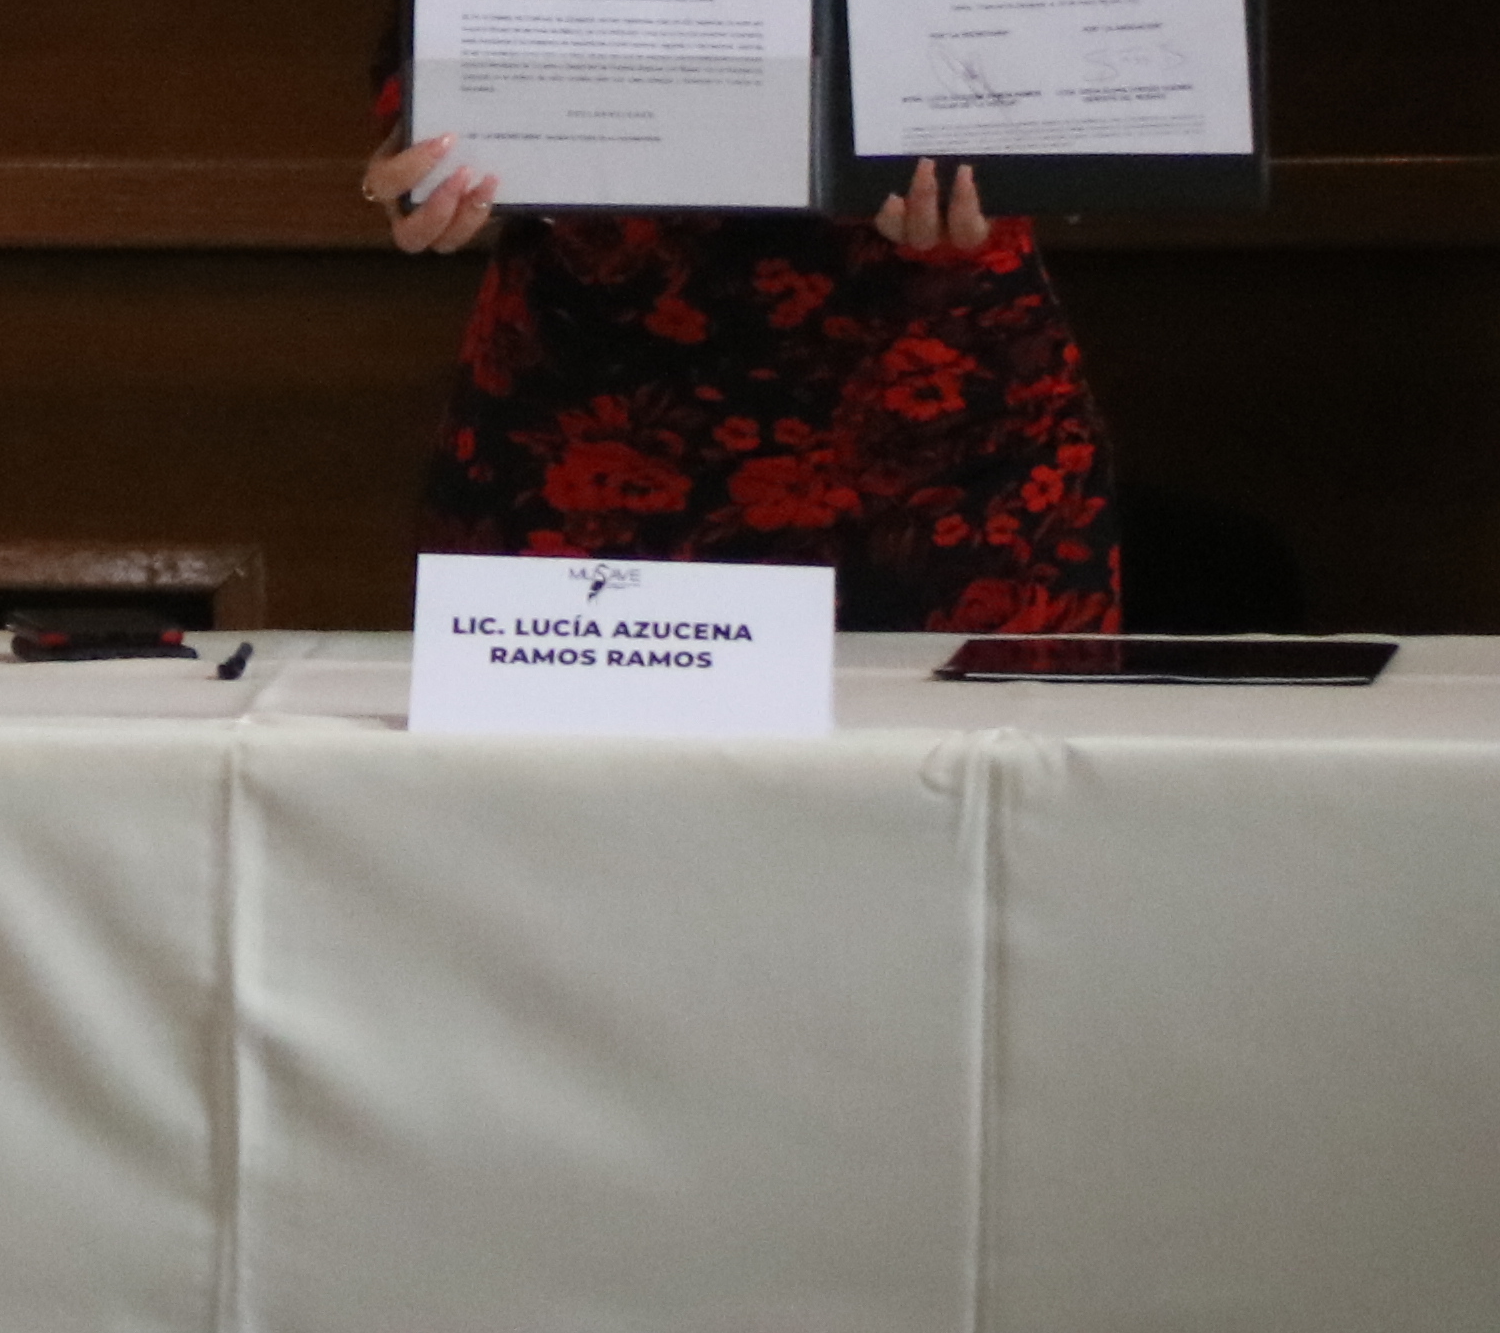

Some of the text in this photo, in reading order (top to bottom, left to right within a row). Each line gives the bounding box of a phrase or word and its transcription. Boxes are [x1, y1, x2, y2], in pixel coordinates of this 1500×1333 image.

[452, 615, 753, 641] LIC. LUCÍA AZUCENA
[490, 646, 714, 669] RAMOS RAMOS
